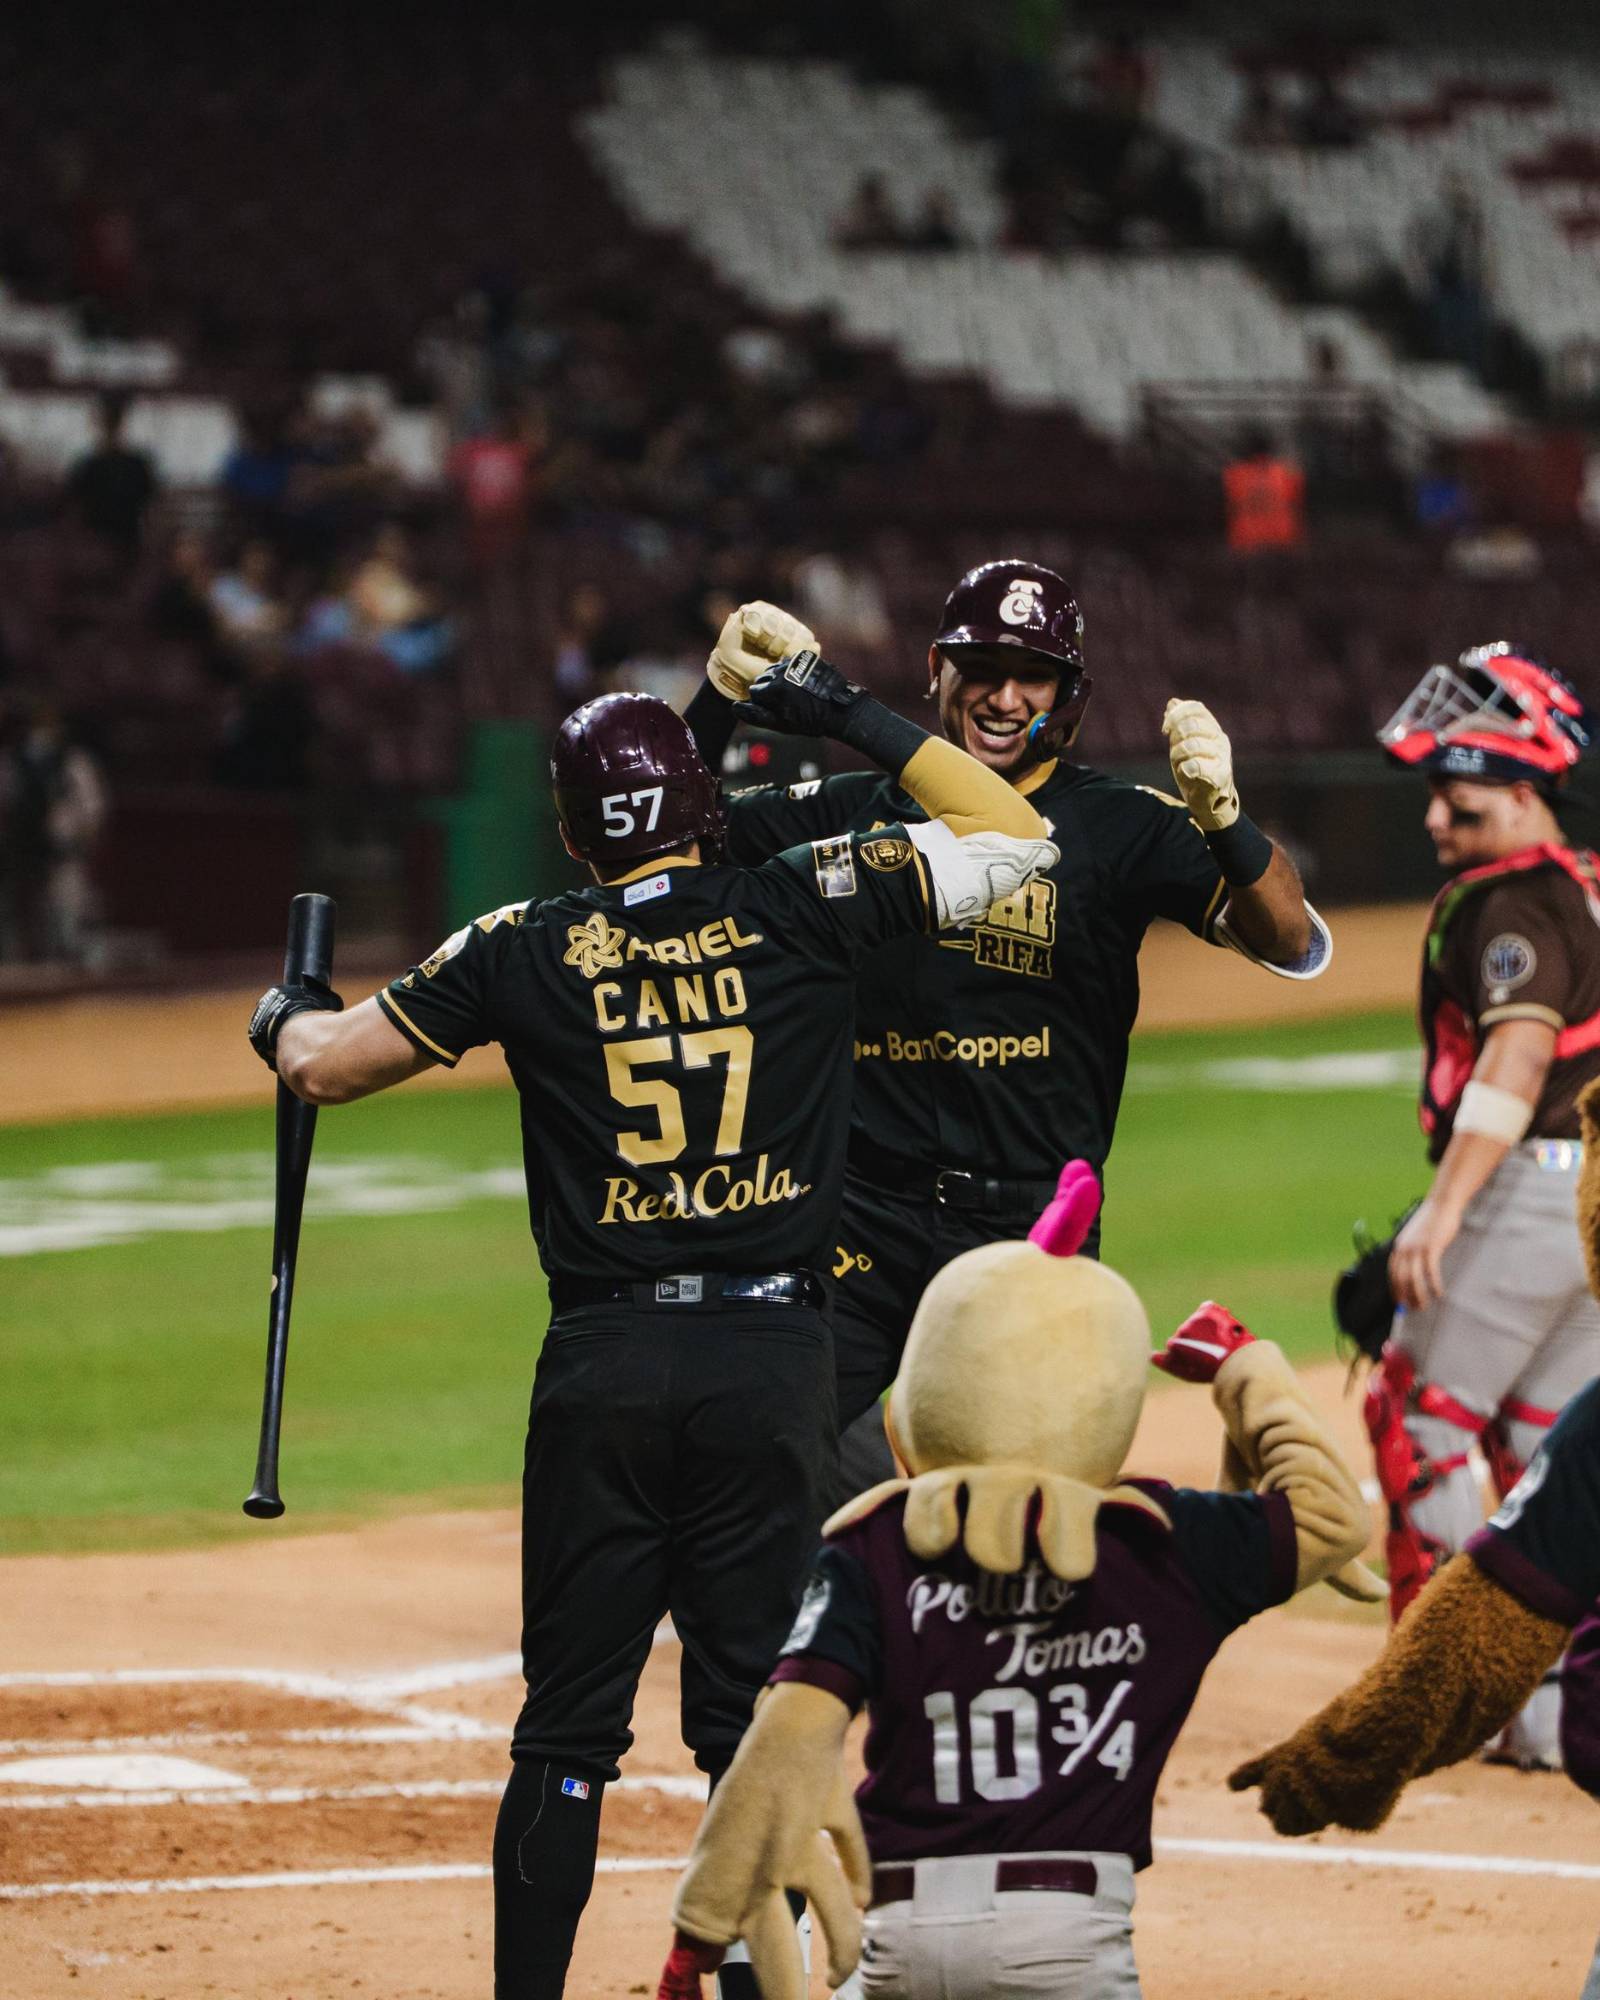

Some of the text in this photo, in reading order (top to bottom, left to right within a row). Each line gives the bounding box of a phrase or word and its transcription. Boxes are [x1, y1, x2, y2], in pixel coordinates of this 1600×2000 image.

[601, 786, 664, 838] 57
[626, 916, 763, 965] ARIEL
[976, 930, 1051, 977] RIFA
[593, 967, 747, 1032] CANO
[886, 1026, 1049, 1068] BanCoppel
[602, 1024, 754, 1166] 57
[985, 1619, 1147, 1682] Tomas
